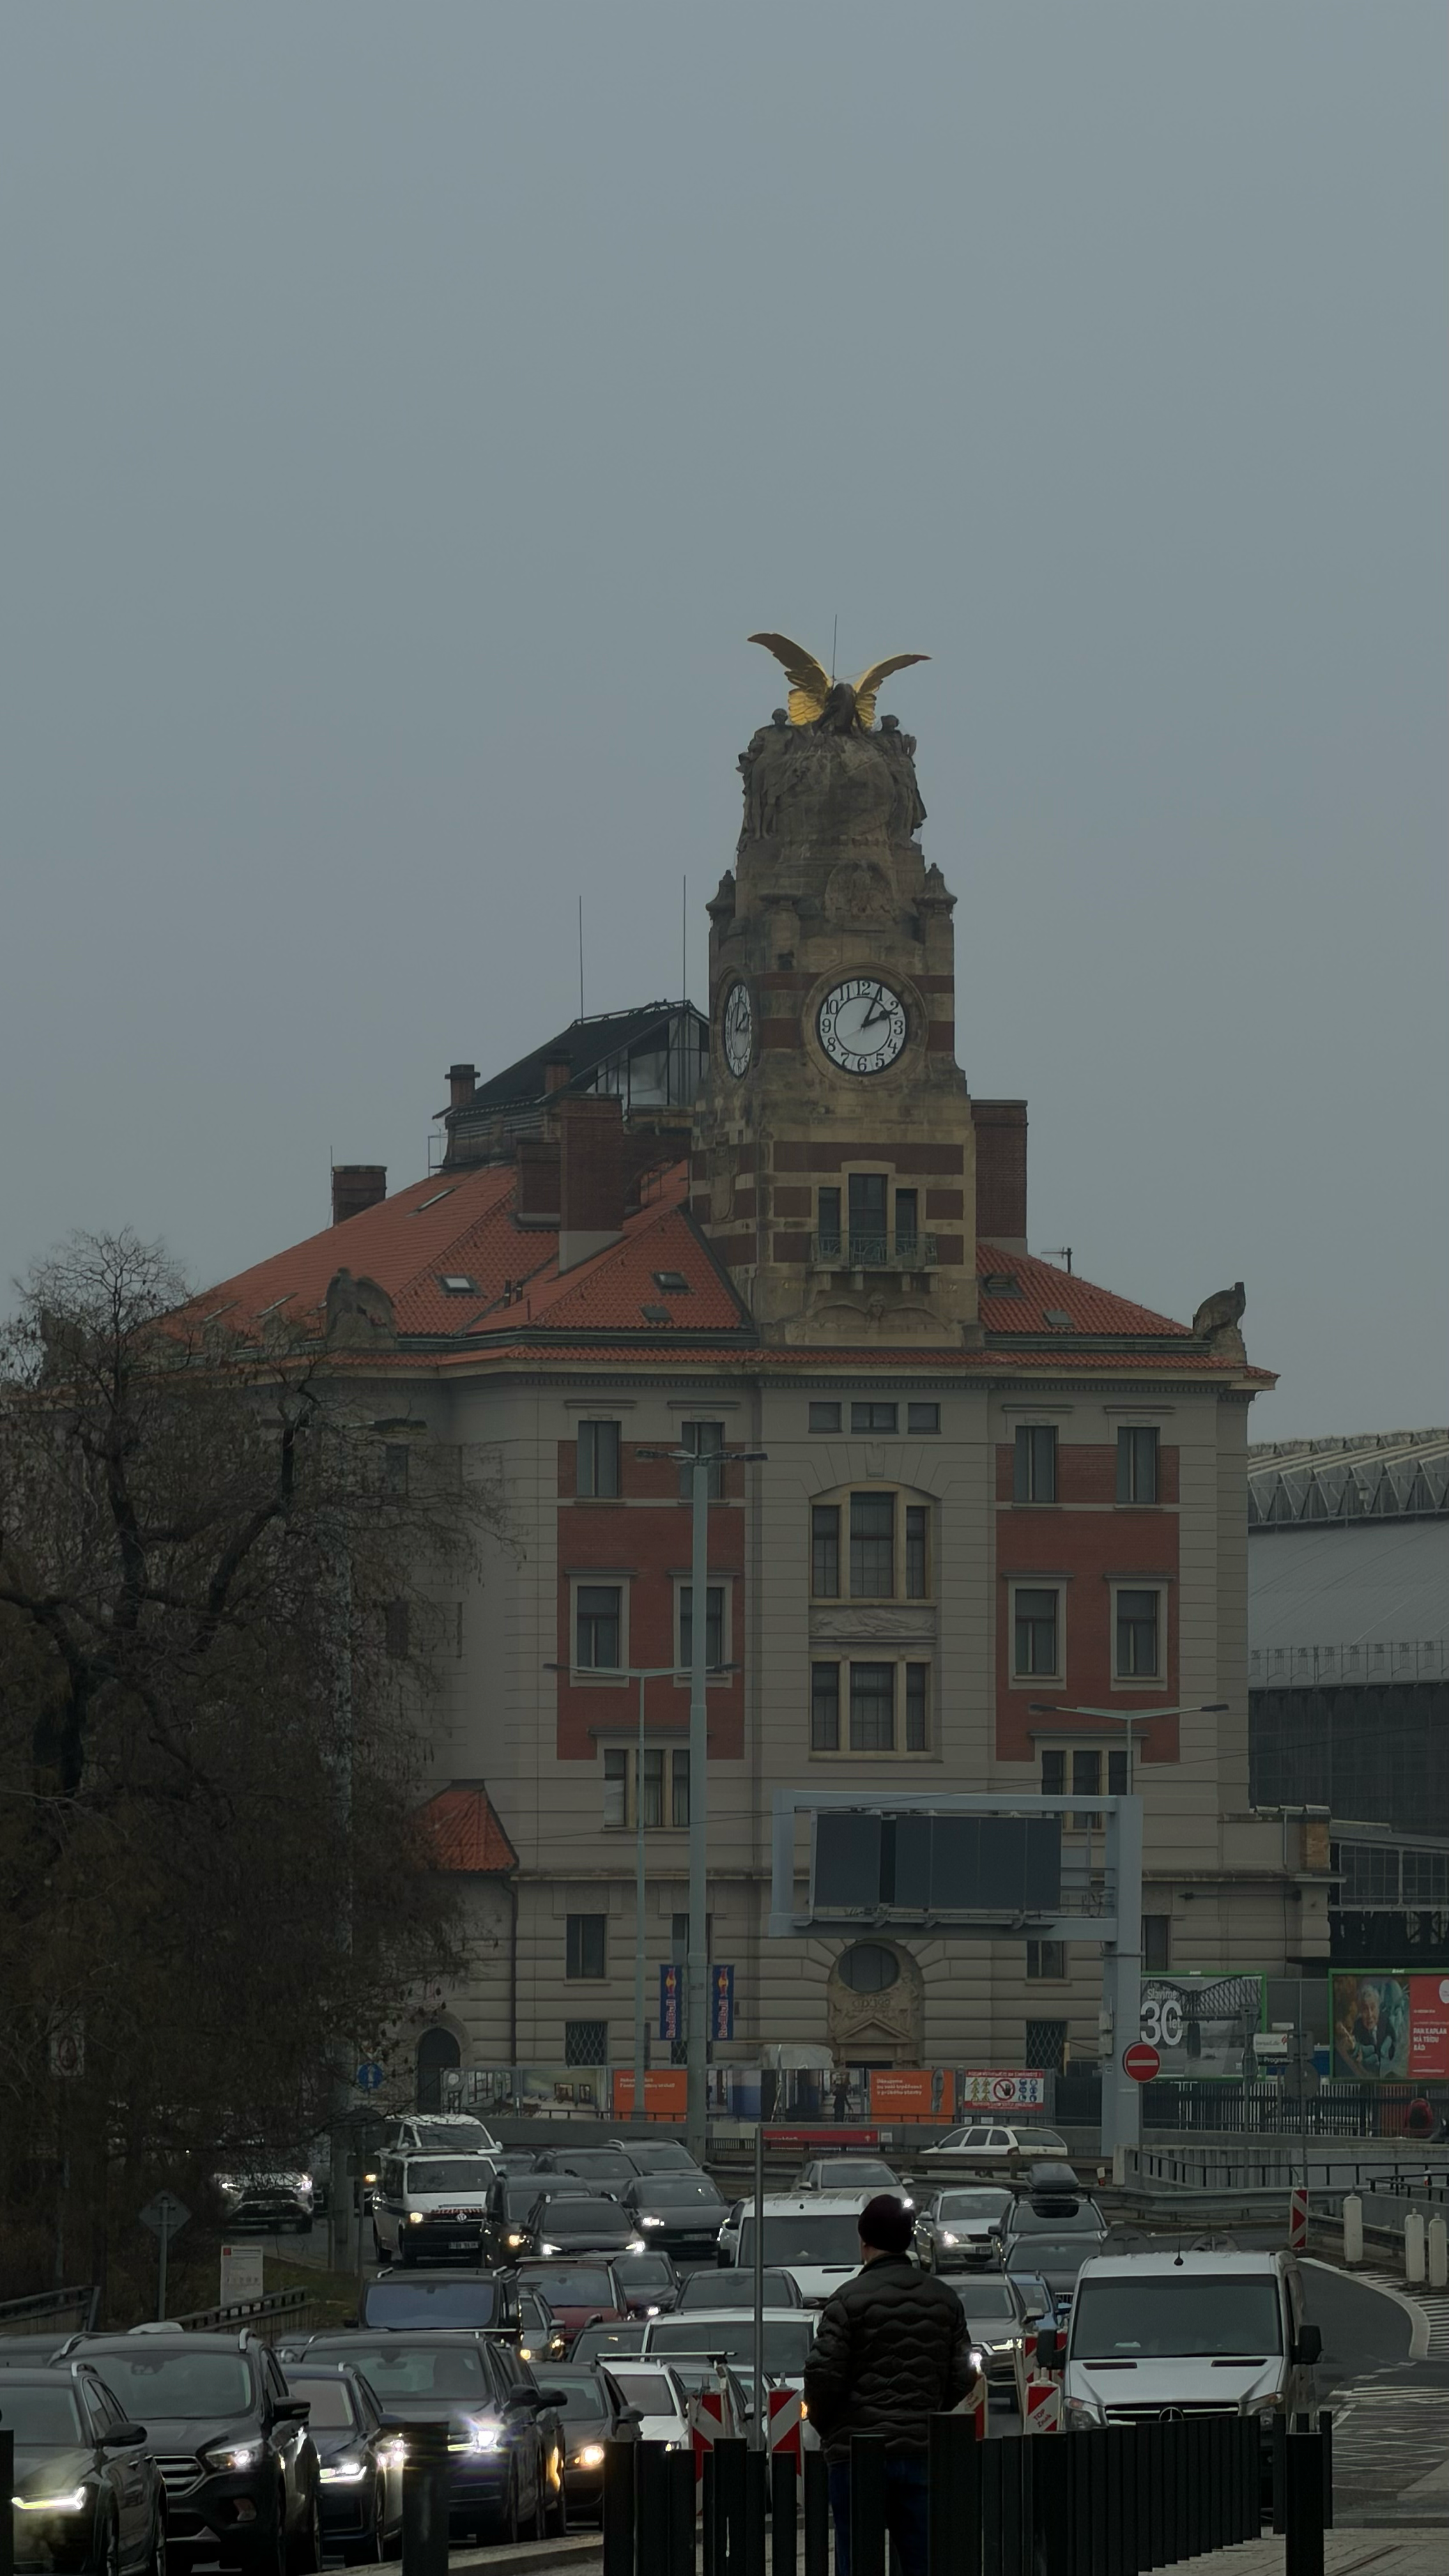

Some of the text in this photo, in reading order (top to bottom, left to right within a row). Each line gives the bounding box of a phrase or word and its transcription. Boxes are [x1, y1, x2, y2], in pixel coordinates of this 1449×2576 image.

[840, 985, 850, 1000] 11
[857, 981, 871, 995] 12
[825, 997, 838, 1015] 10
[890, 1000, 899, 1015] 2
[822, 1018, 831, 1033] 9
[894, 1020, 903, 1034] 3
[827, 1037, 836, 1052] 8
[887, 1038, 898, 1054] 4
[841, 1052, 850, 1068] 7
[857, 1056, 867, 1072] 6
[875, 1053, 885, 1068] 5
[1033, 2409, 1045, 2420] TOP
